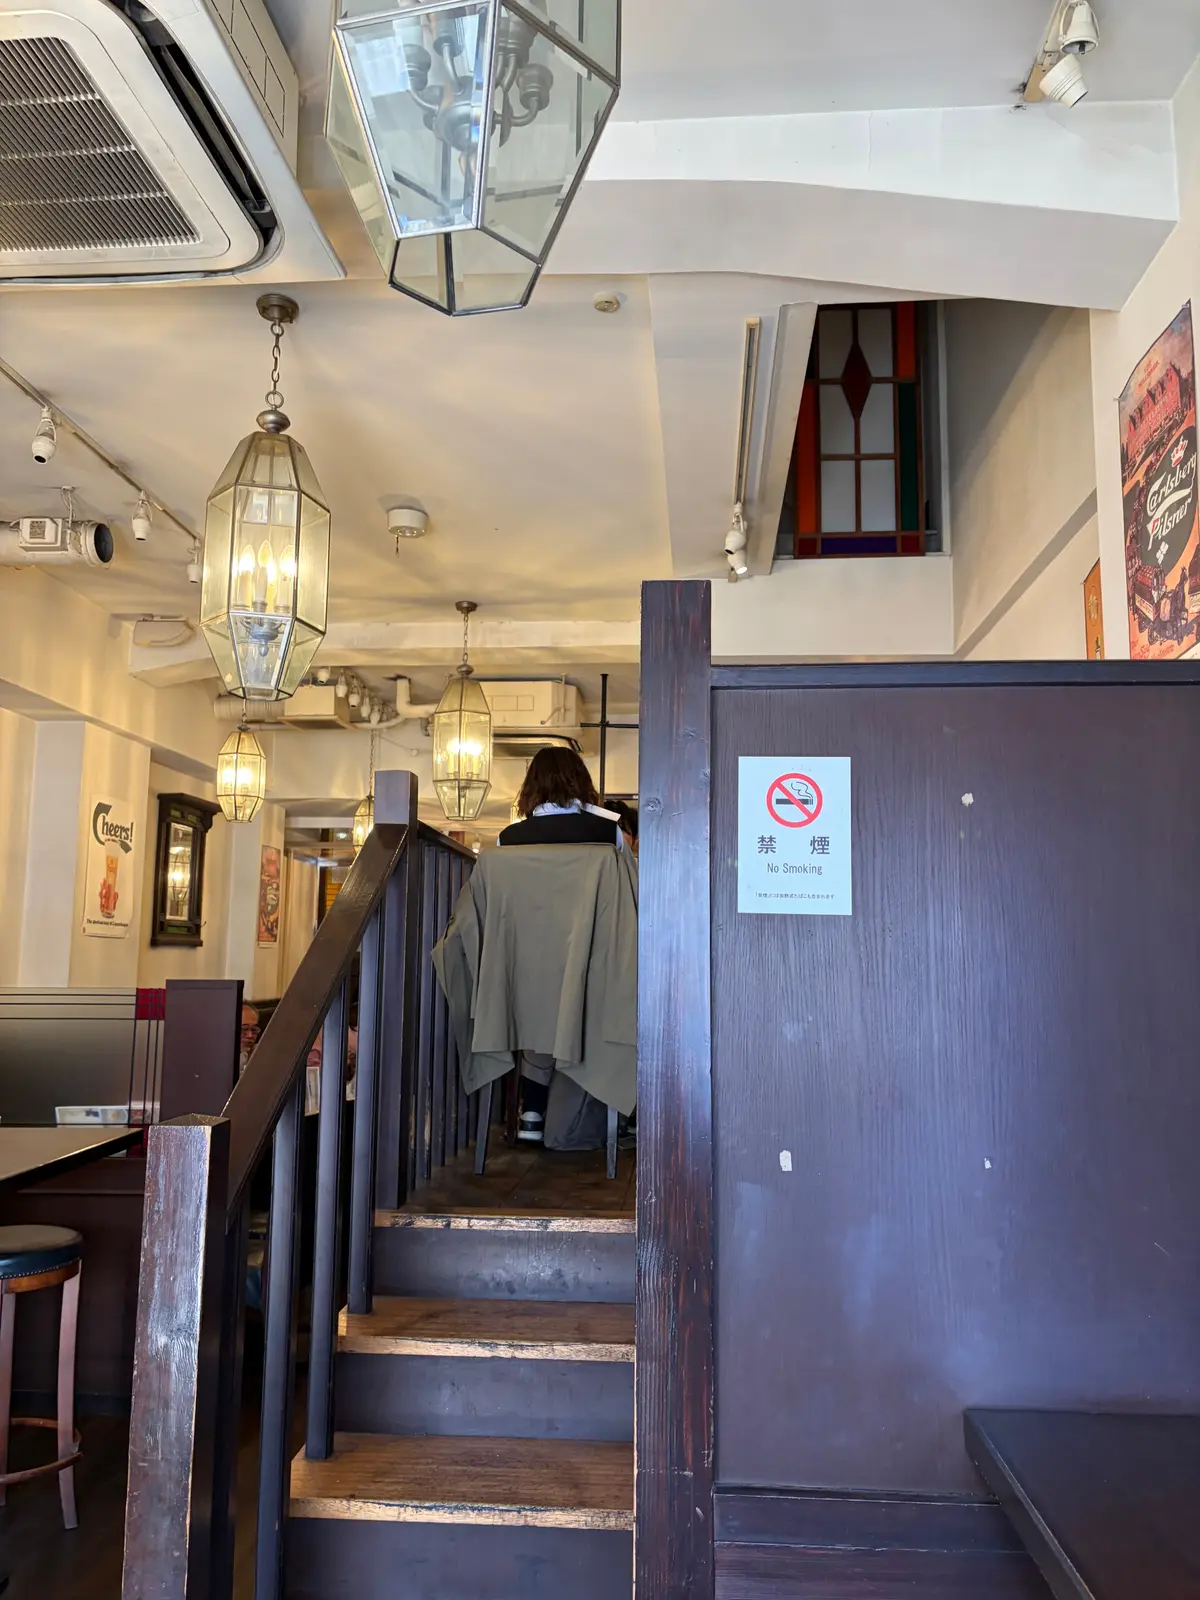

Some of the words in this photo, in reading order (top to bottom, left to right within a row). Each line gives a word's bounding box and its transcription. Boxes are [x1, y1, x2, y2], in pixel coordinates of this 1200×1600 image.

[1146, 451, 1197, 517] Carlsberg
[1146, 497, 1192, 551] Pilsner
[93, 801, 134, 854] Cheers!
[767, 863, 780, 874] No
[782, 863, 823, 876] Smoking
